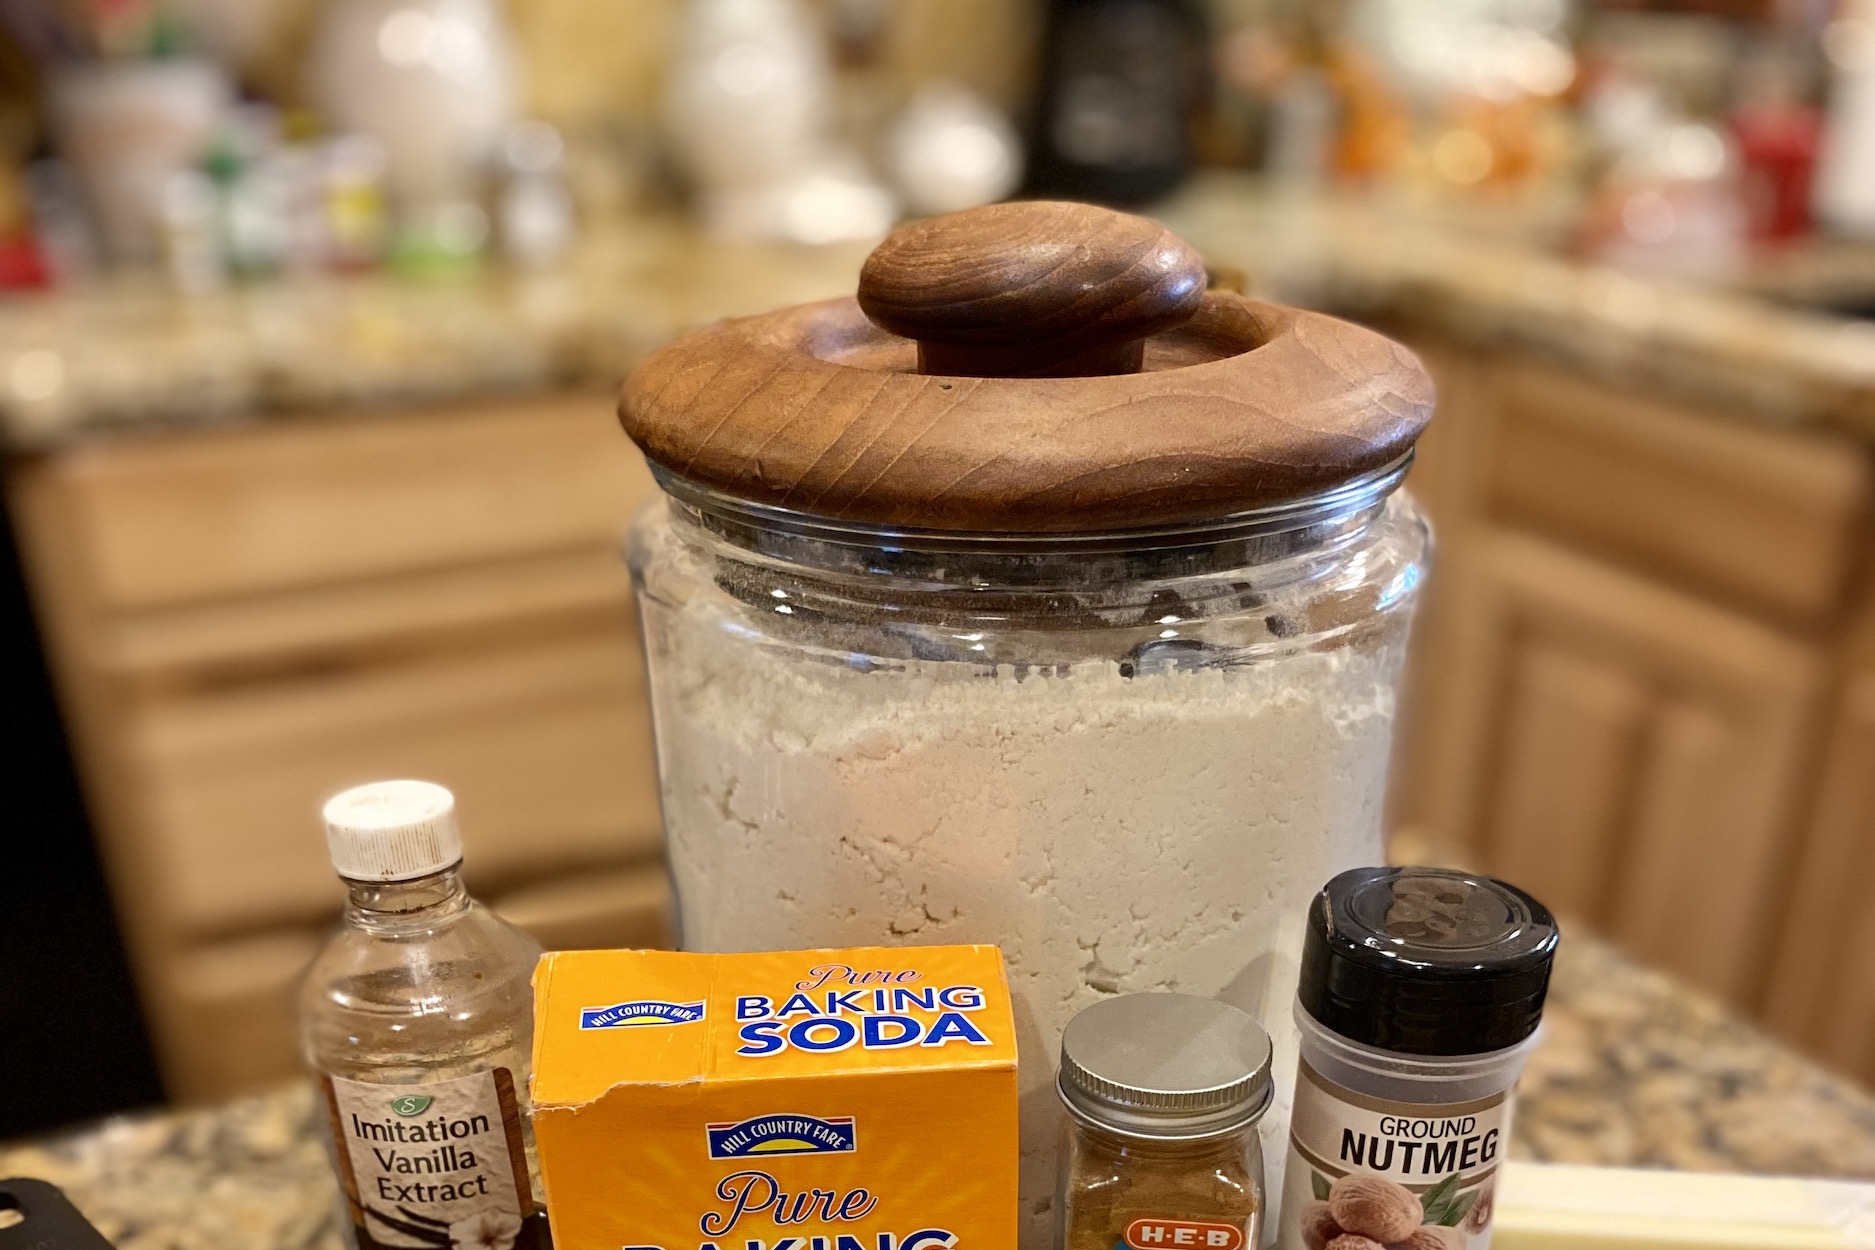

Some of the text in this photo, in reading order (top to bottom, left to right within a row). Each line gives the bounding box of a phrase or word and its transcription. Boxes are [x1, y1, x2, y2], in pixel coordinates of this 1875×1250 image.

[795, 963, 924, 991] Pure
[591, 1005, 697, 1026] HILL COUNTRY FARE
[736, 986, 986, 1020] BAKING
[734, 1011, 993, 1058] SODA
[352, 1113, 489, 1143] Imitation
[721, 1121, 846, 1153] HILL COUNTRY FARE
[1380, 1116, 1476, 1138] GROUND
[373, 1146, 478, 1174] Vanilla
[1340, 1128, 1499, 1174] NUTMEG
[377, 1174, 488, 1203] Extract
[700, 1170, 878, 1236] Pure
